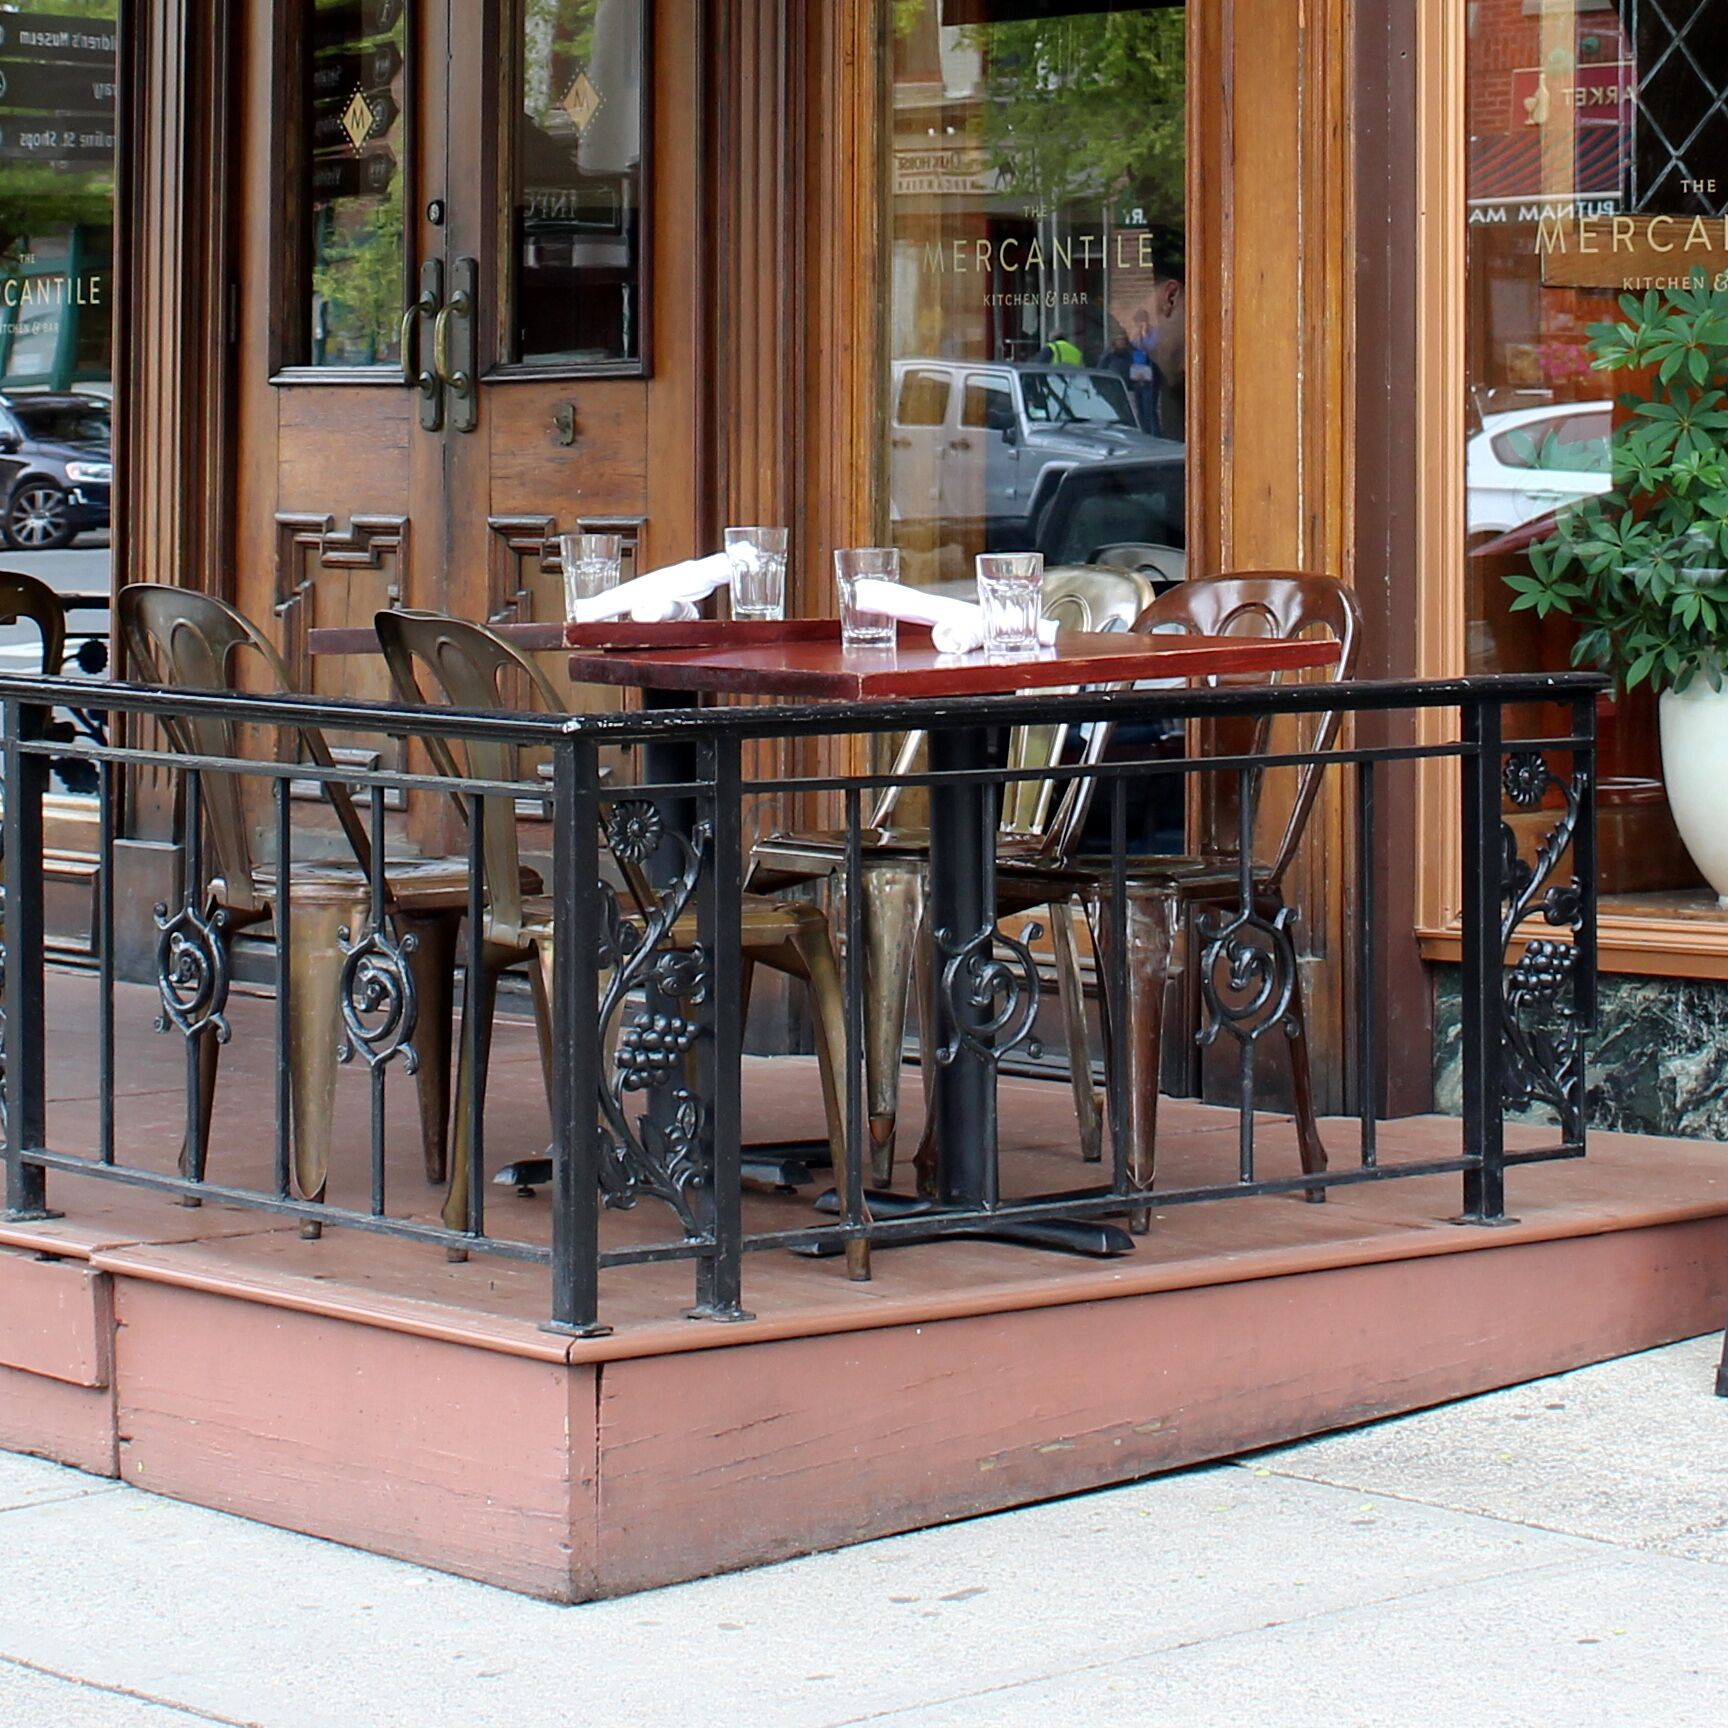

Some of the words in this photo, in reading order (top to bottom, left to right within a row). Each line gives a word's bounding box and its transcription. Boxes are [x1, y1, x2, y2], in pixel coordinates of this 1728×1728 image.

[1680, 179, 1716, 193] THE
[1024, 205, 1048, 218] THE
[19, 254, 36, 264] THE
[923, 234, 1154, 272] MERCANTILE
[1623, 275, 1705, 290] KITCHEN
[1713, 273, 1728, 292] &
[983, 293, 1039, 307] KITCHEN
[1045, 290, 1057, 308] &
[1063, 291, 1088, 305] BAR
